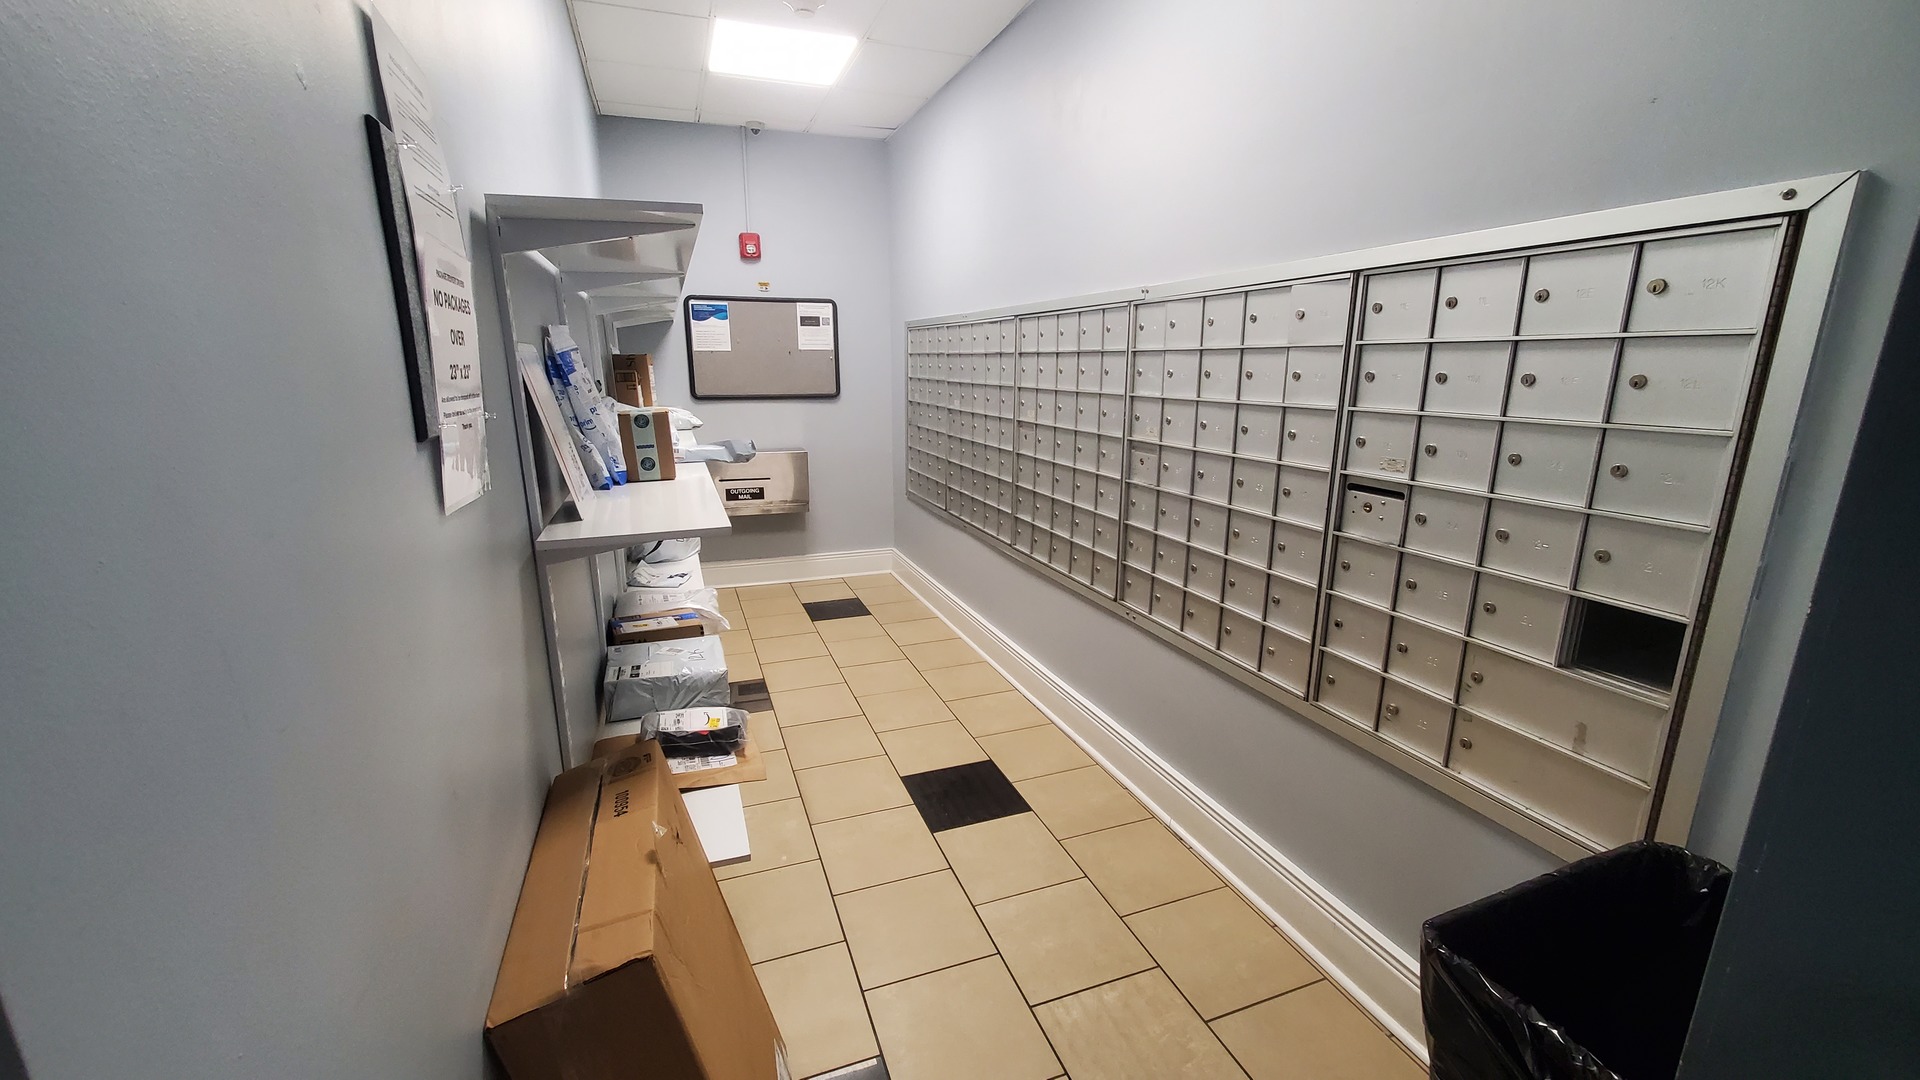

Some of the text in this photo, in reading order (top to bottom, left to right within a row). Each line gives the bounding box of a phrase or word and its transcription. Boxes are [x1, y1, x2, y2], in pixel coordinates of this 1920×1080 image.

[1702, 276, 1727, 291] 12K
[433, 288, 471, 316] NO PACKAGES
[450, 328, 466, 347] OVER
[449, 363, 459, 381] 23"
[730, 487, 760, 495] OUTGOING
[613, 789, 630, 818] 100954
